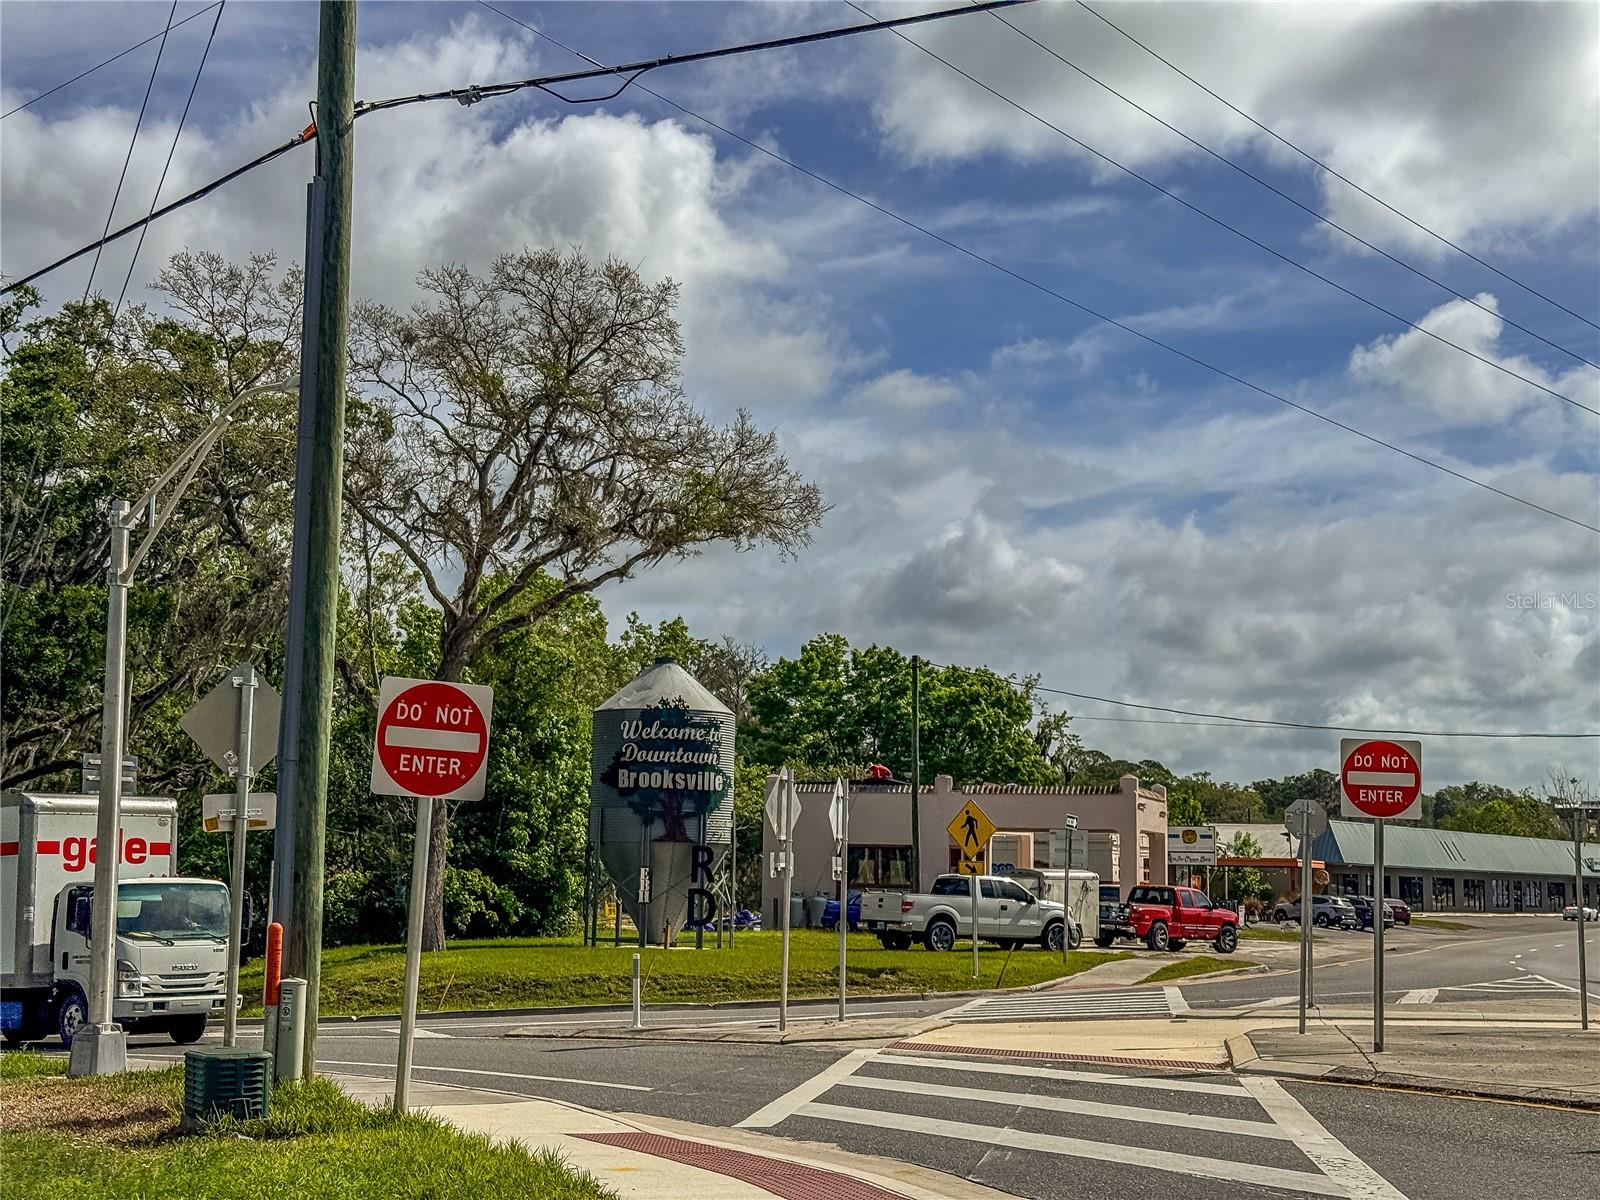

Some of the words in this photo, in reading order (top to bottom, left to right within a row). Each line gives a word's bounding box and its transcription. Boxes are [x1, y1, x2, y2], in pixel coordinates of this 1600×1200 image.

[396, 702, 422, 721] DO
[435, 705, 473, 726] NOT
[620, 720, 706, 740] Welcome
[708, 727, 721, 742] to
[620, 742, 719, 765] Downtown
[1354, 755, 1372, 768] DO
[1381, 756, 1409, 769] NOT
[399, 754, 461, 776] ENTER
[618, 768, 723, 791] Brooksville
[1359, 789, 1403, 803] ENTER
